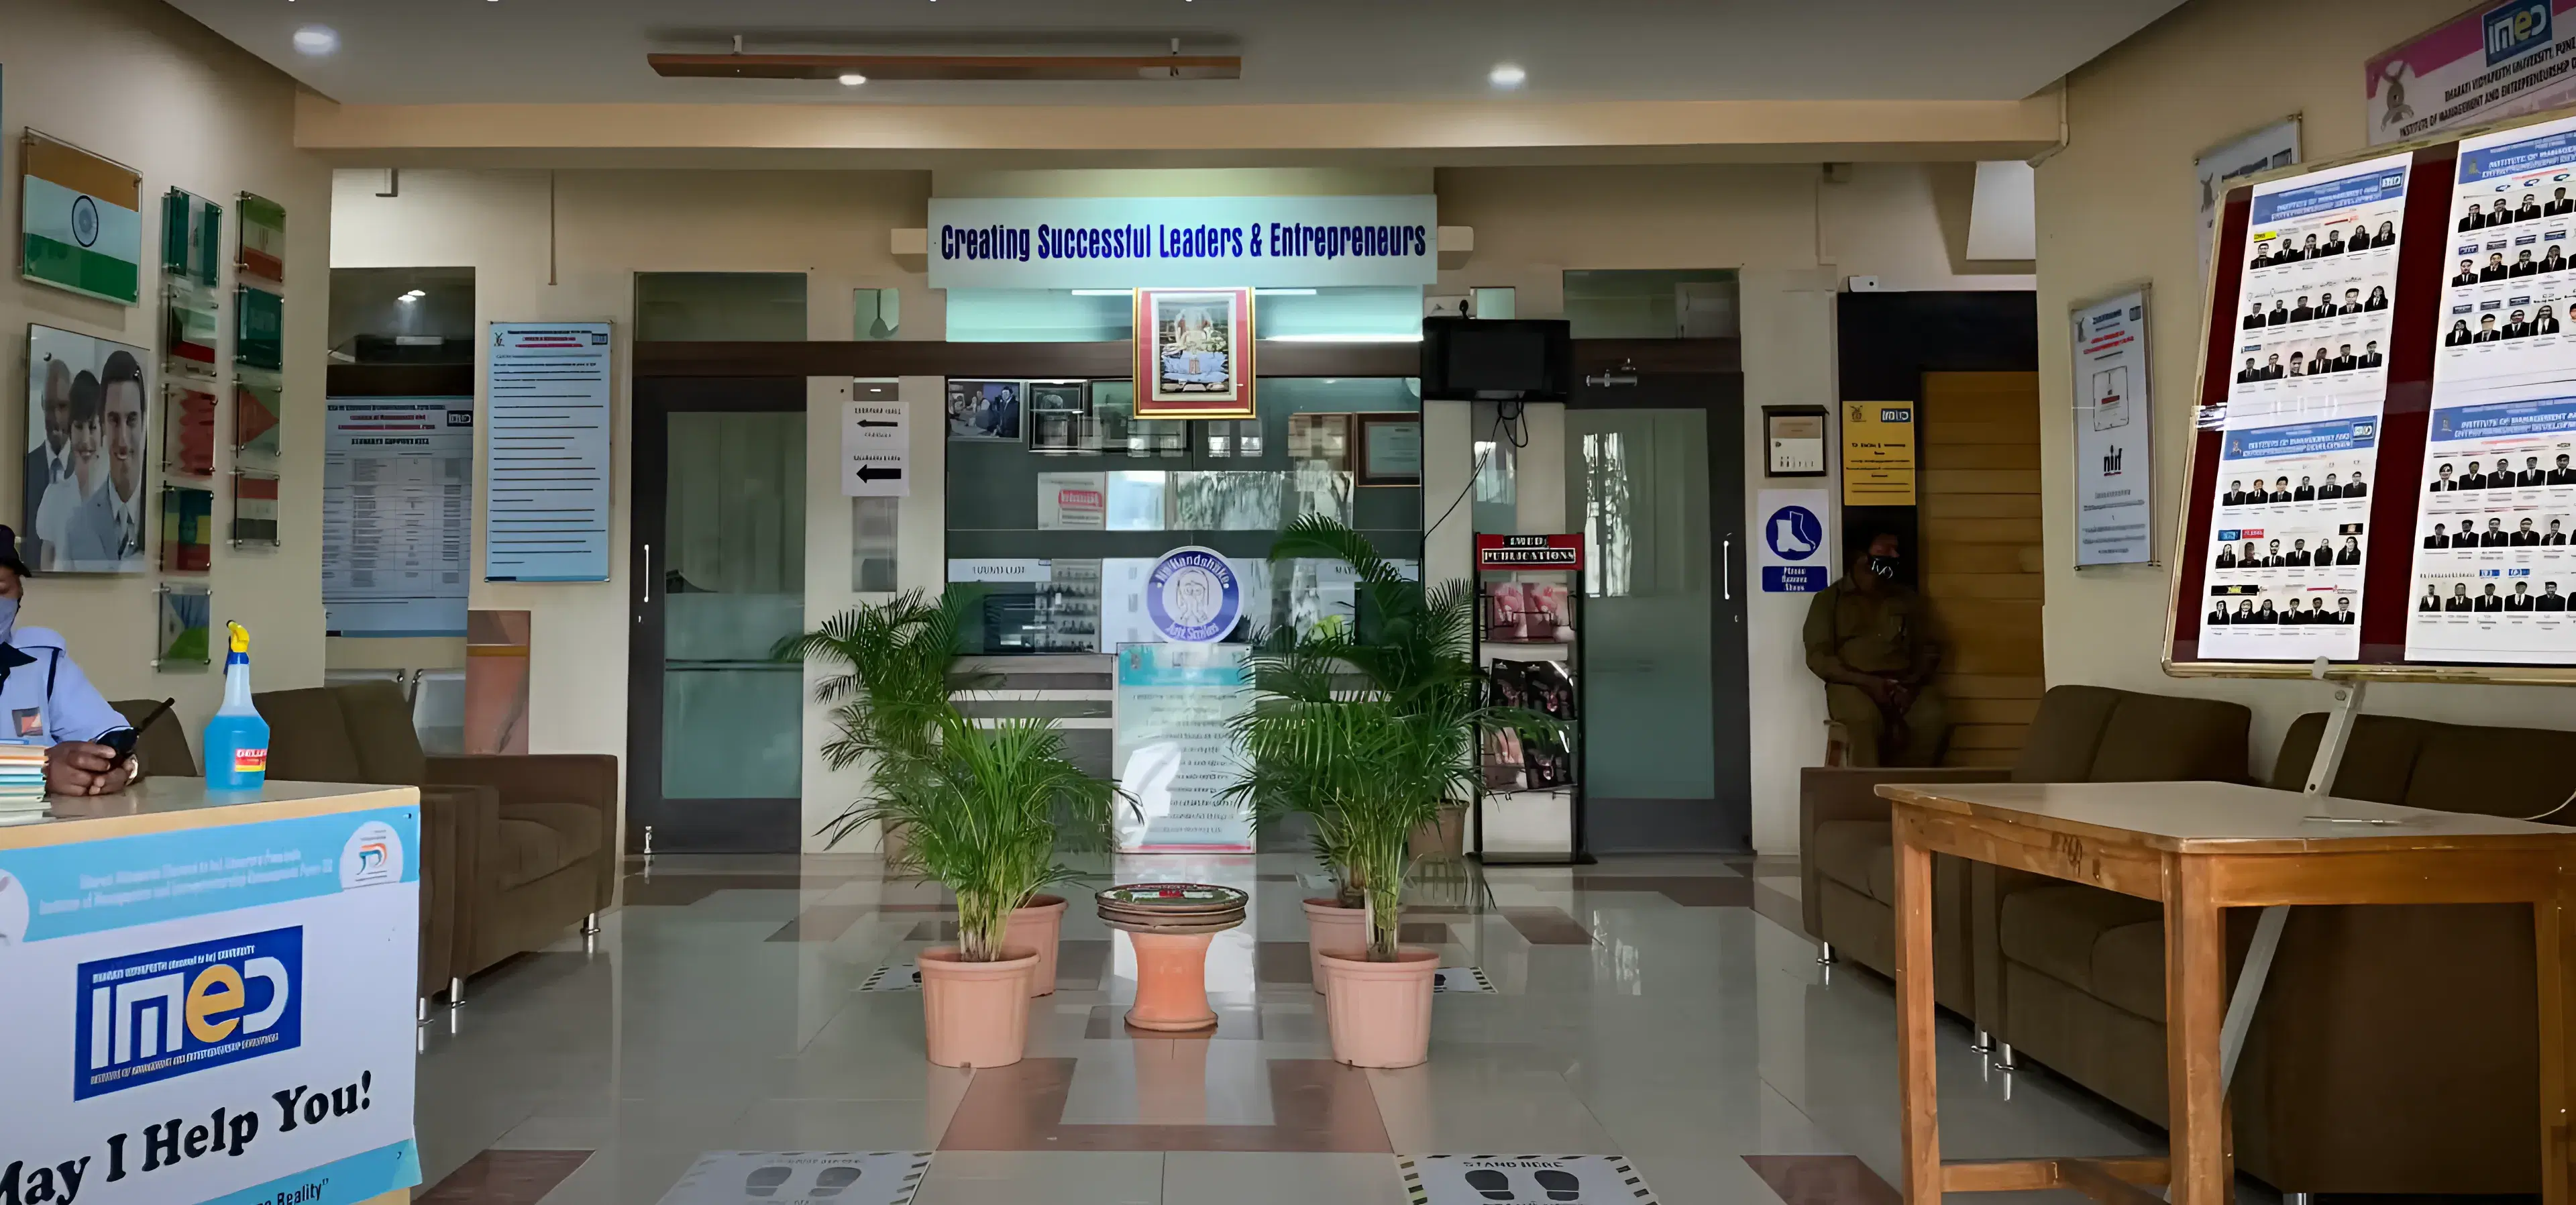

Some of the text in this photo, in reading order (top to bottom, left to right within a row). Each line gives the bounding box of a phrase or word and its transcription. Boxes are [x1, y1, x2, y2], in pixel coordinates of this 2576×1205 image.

[941, 222, 1426, 262] Creating Successful Leaders & Entrepreneurs
[1484, 551, 1575, 561] PUBLICATIONS
[106, 1133, 127, 1183] I
[142, 1106, 260, 1172] Help
[271, 1069, 372, 1133] You!
